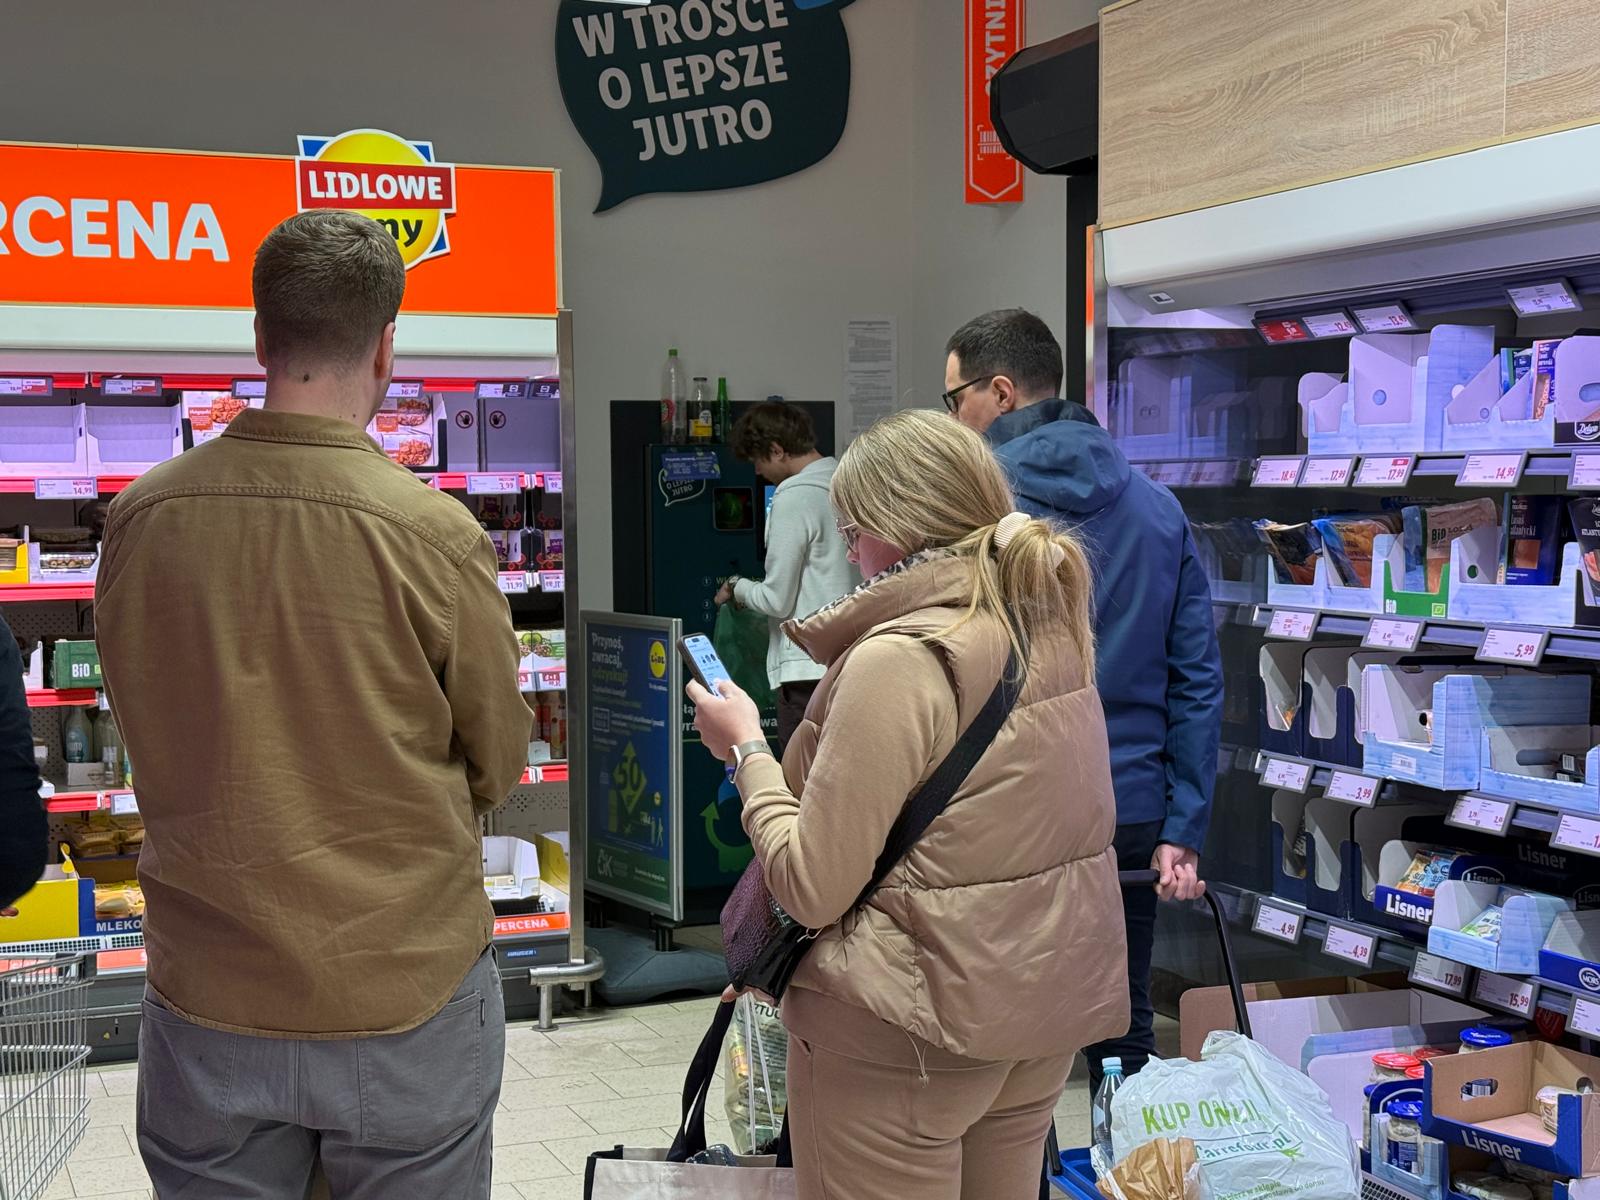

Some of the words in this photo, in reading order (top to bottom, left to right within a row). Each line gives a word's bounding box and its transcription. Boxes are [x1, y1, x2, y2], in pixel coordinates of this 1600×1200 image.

[572, 12, 616, 58] W
[598, 67, 632, 110] O
[640, 40, 788, 104] LEPSZE
[633, 98, 773, 162] JUTRO
[307, 169, 444, 201] LIDLOWE
[0, 195, 230, 263] CENA
[1517, 843, 1567, 869] Lisner
[1385, 893, 1433, 923] Lisner
[96, 919, 142, 932] MLEKO
[1141, 1101, 1192, 1135] KUP
[1460, 1129, 1523, 1161] Lisner
